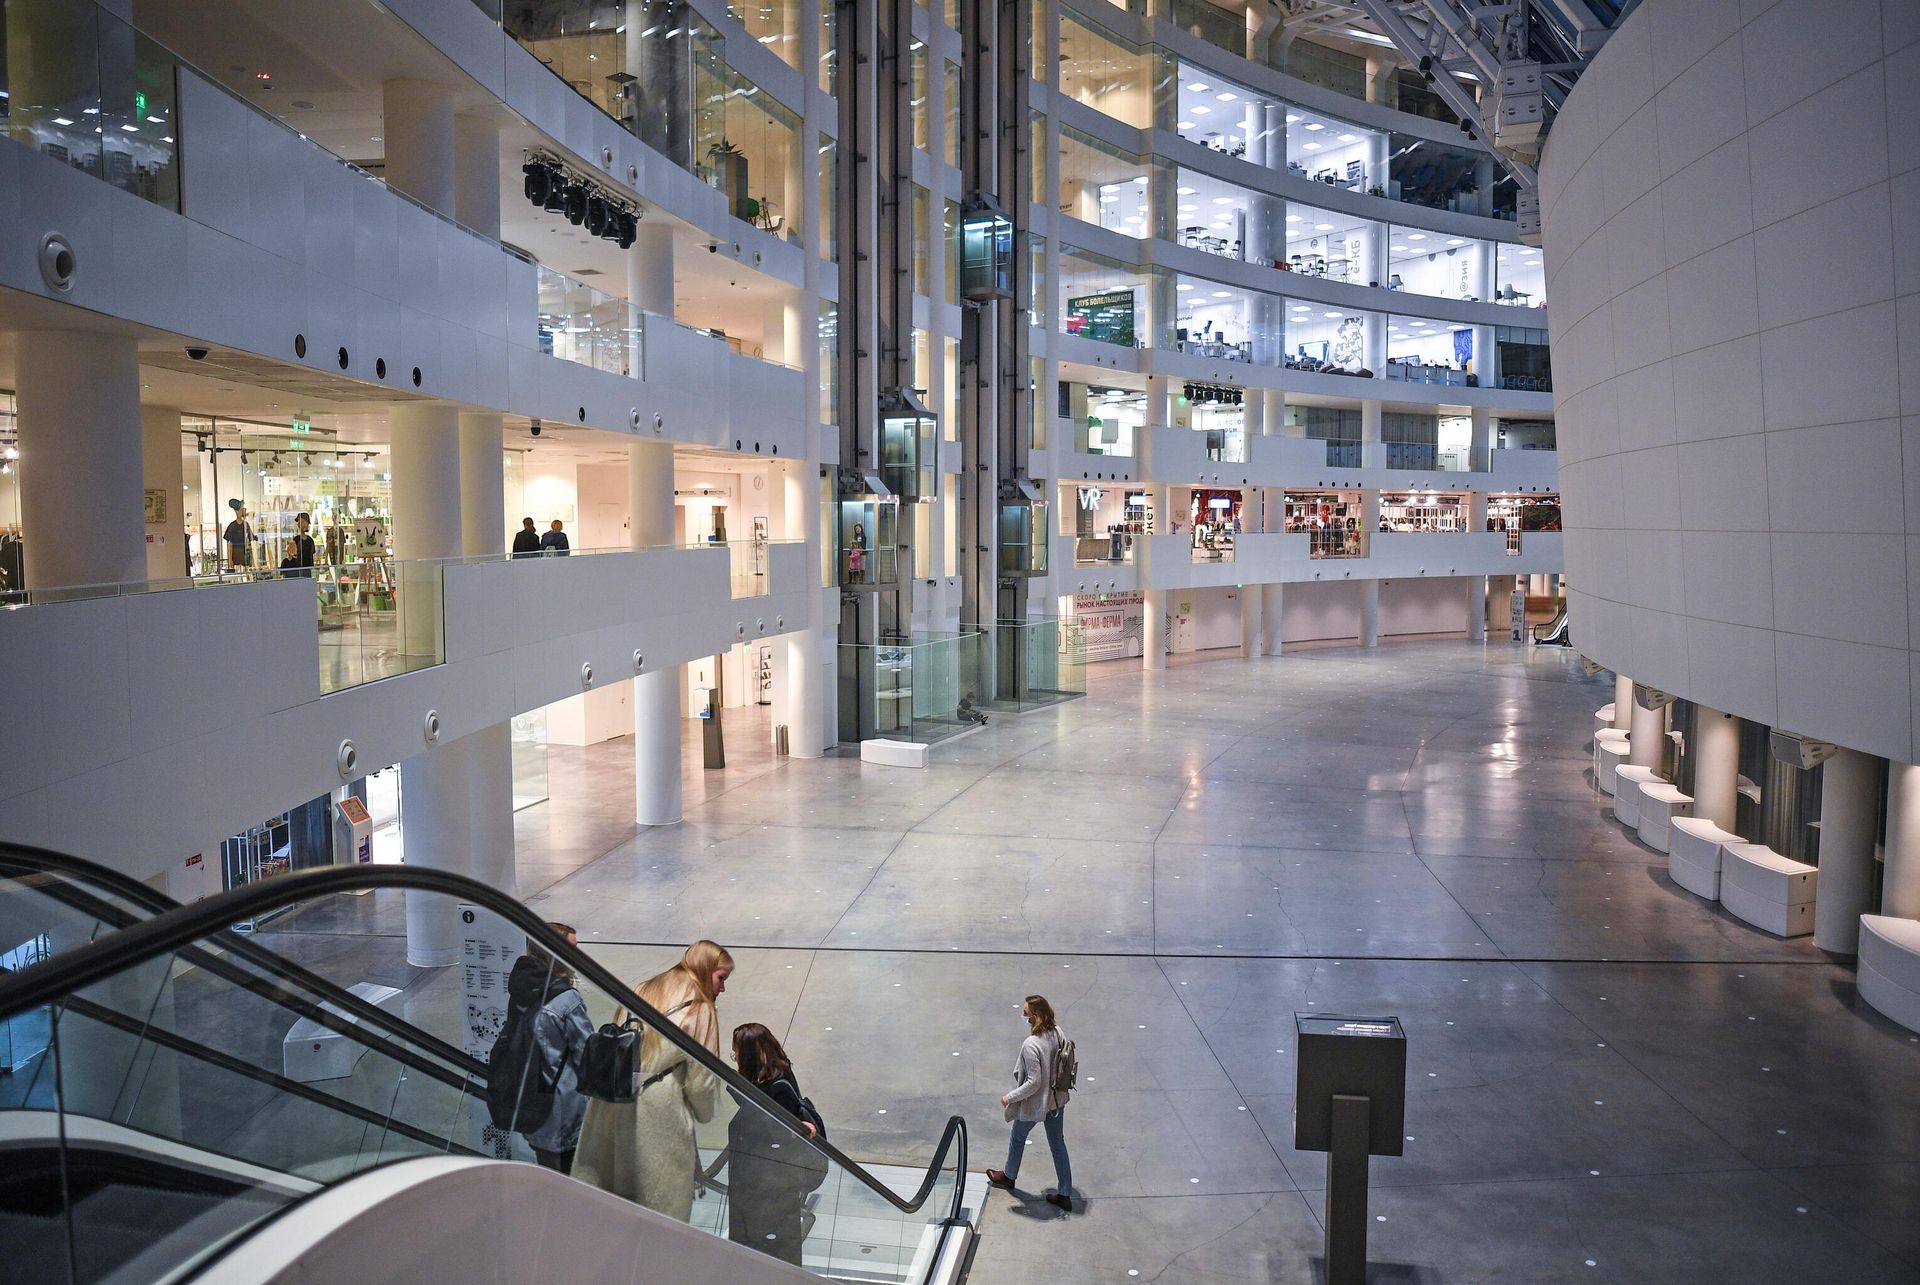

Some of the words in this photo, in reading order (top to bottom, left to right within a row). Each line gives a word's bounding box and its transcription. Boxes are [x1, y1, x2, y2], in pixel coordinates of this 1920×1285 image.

[1078, 488, 1100, 511] VR
[1077, 601, 1095, 609] РЫНОК
[1095, 598, 1128, 608] НАСТОЯЩИХ
